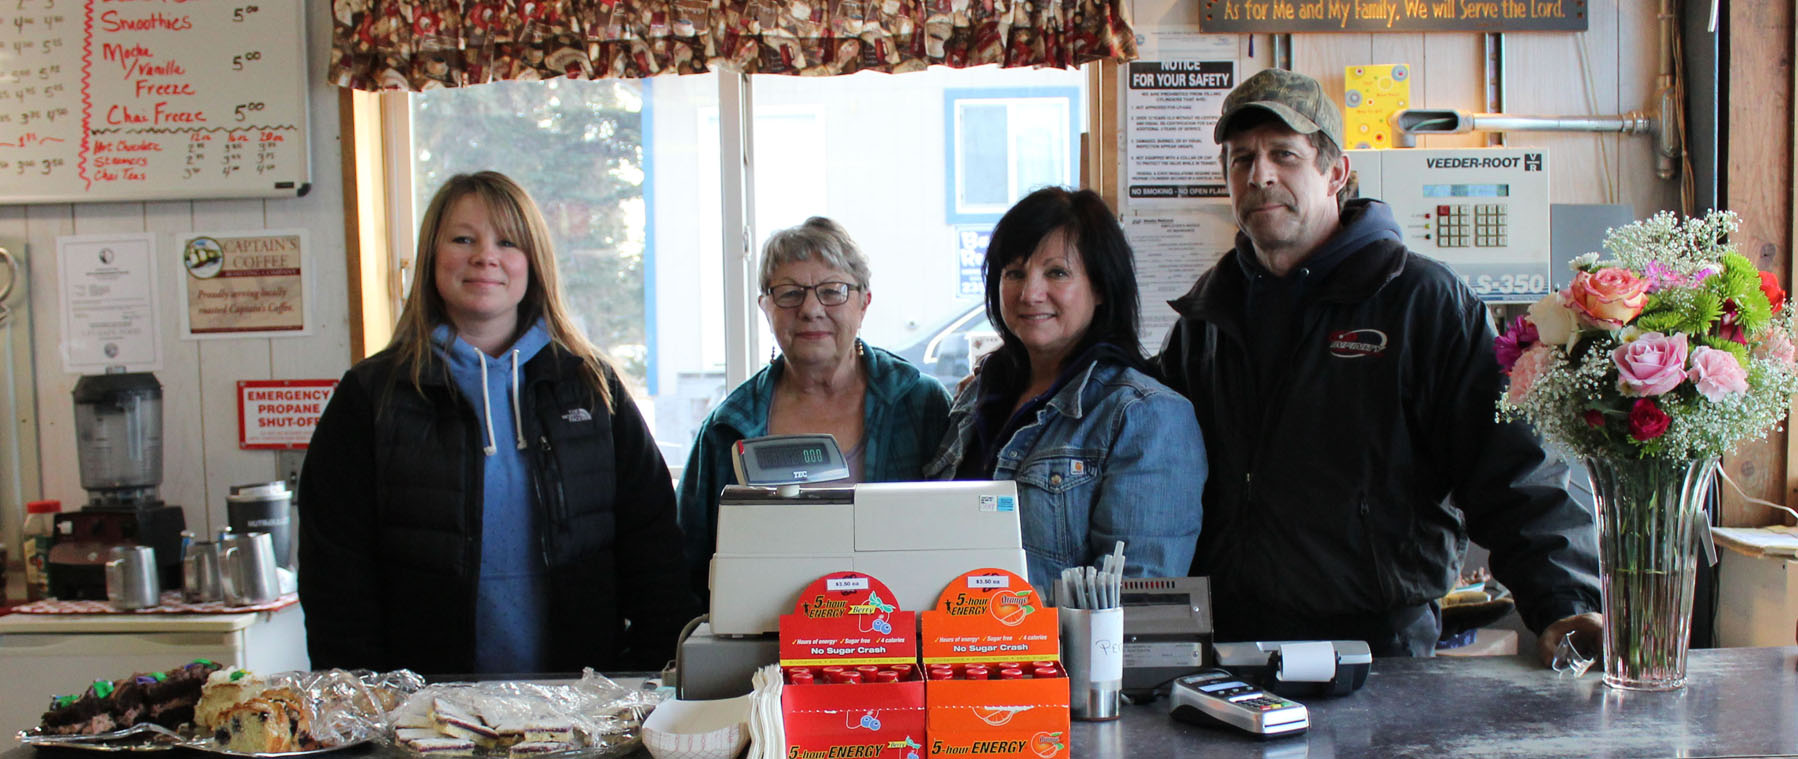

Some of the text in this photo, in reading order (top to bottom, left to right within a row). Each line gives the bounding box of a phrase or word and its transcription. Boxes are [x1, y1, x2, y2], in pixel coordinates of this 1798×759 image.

[1224, 0, 1239, 20] As
[1245, 0, 1267, 20] for
[1273, 0, 1295, 20] Me
[1299, 0, 1324, 20] and
[1328, 0, 1349, 28] My
[1404, 0, 1428, 19] We
[1432, 0, 1455, 19] will
[1460, 0, 1498, 19] Serve
[1503, 0, 1526, 19] the
[1531, 0, 1566, 19] Lord.
[100, 10, 192, 32] Smoothies
[1161, 61, 1201, 71] NOTICE
[1133, 73, 1230, 87] FOR YOUR SAFETY
[136, 80, 196, 97] Freeze
[106, 104, 149, 126] Chai
[154, 102, 207, 125] Freeze
[1426, 157, 1520, 169] VEEDER-ROOT
[223, 238, 298, 253] CAPTAIN'S
[233, 254, 288, 268] COFFEE
[247, 390, 330, 401] EMERGENCY
[258, 404, 320, 414] PROPANE
[814, 595, 848, 608] 5-hour
[956, 593, 989, 606] 5-hour
[809, 608, 846, 618] ENERGY
[951, 606, 987, 616] ENERGY
[811, 646, 886, 656] No Sugar Crash
[969, 645, 997, 653] Sugar
[1000, 643, 1029, 651] Crash
[788, 744, 884, 759] 5-hour ENERGY
[931, 741, 1027, 755] 5-hour ENERGY
